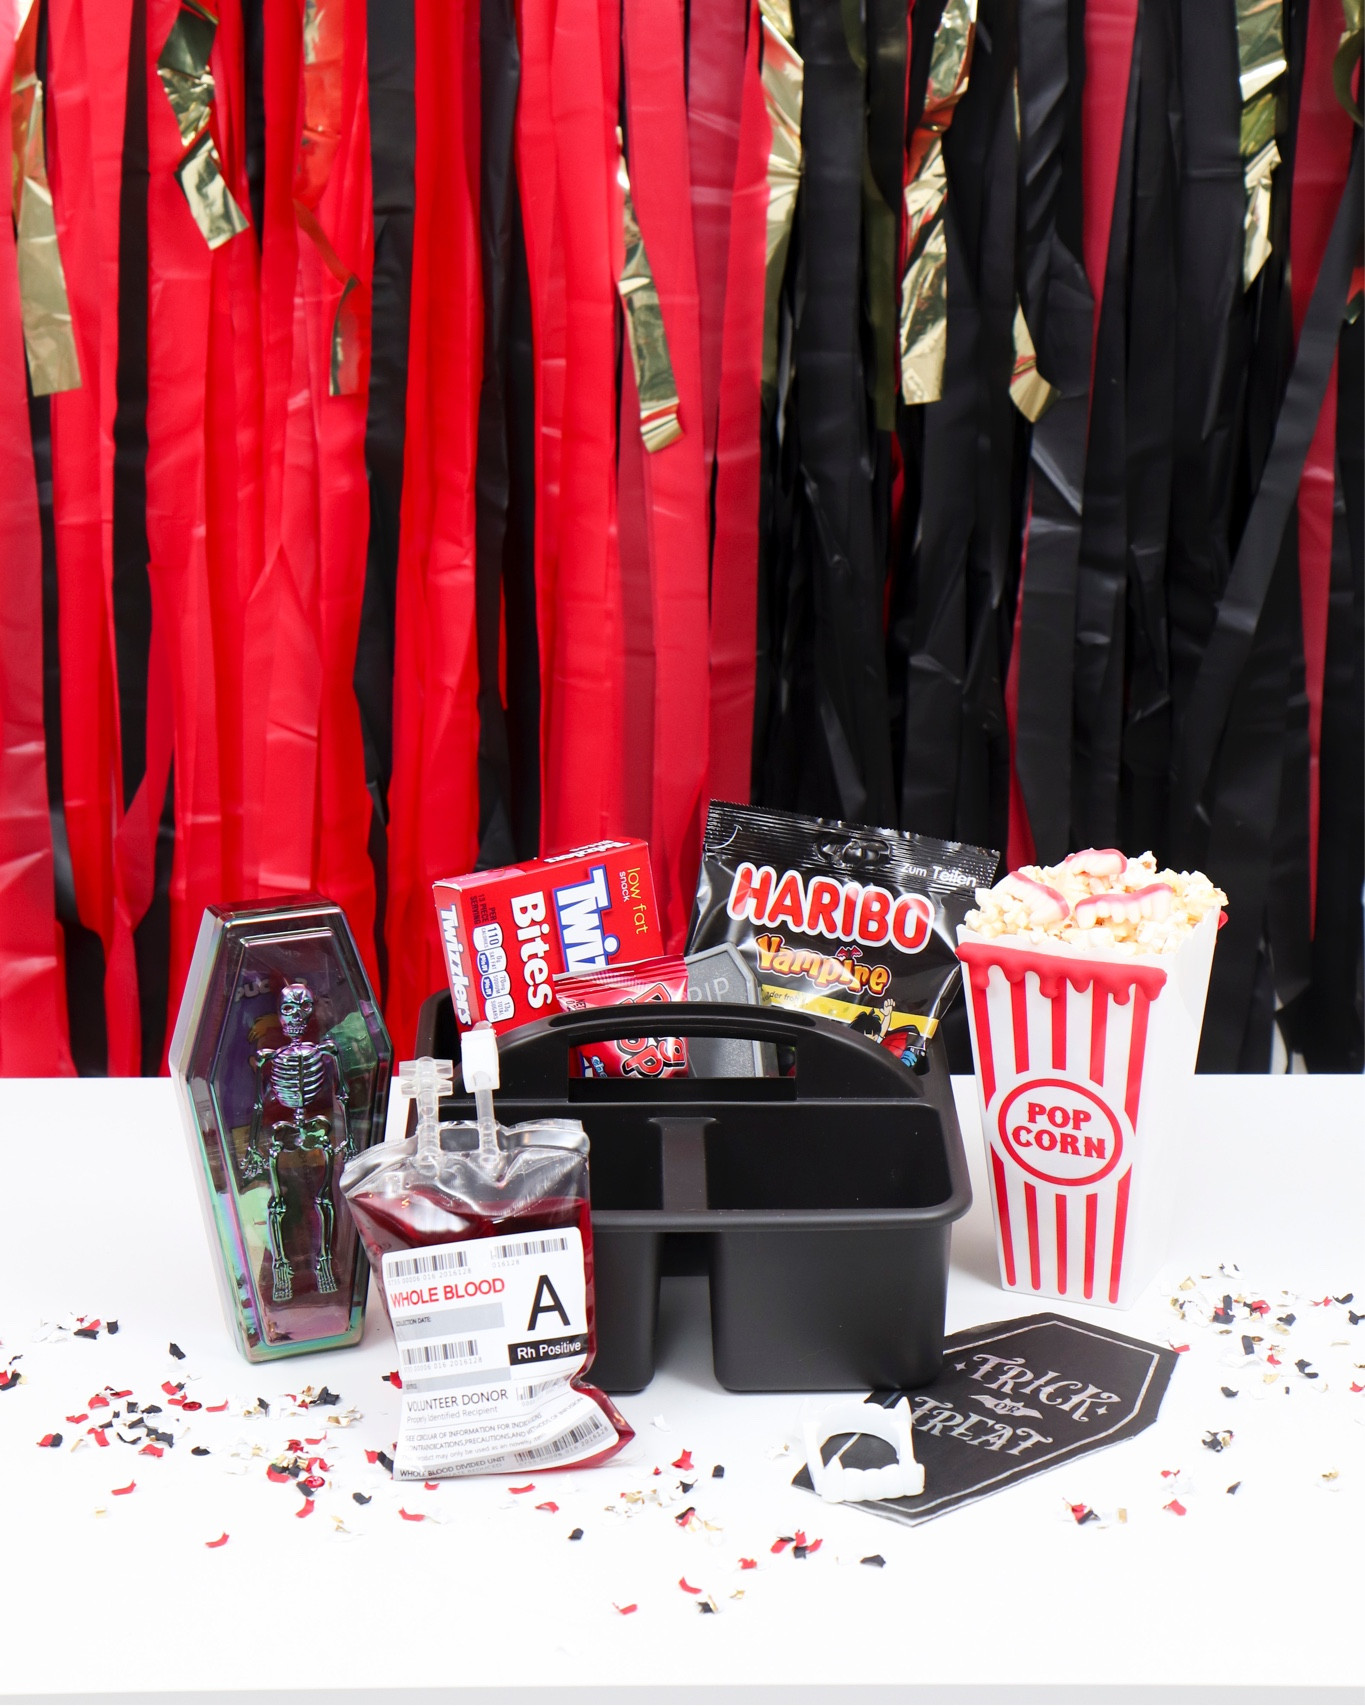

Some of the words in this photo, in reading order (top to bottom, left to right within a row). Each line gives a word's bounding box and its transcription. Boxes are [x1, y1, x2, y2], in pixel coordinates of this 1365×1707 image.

[618, 871, 629, 902] snack
[627, 867, 641, 899] low
[931, 866, 977, 888] Teilen
[470, 896, 480, 924] SERVING
[480, 903, 489, 923] PIECE
[489, 907, 497, 920] PER
[632, 903, 648, 934] fat
[728, 863, 934, 951] HARIBO
[487, 927, 500, 946] 110
[510, 891, 552, 1009] Bites
[441, 904, 472, 1026] Twizzlers
[756, 934, 891, 996] Vampire
[1027, 1101, 1092, 1133] POP
[1011, 1126, 1107, 1160] CORN
[390, 1287, 440, 1308] WHOLE
[443, 1278, 505, 1300] BLOOD
[527, 1275, 571, 1331] A
[517, 1347, 536, 1360] Rh
[539, 1341, 581, 1356] Positive
[407, 1396, 459, 1412] VOLUNTEER
[461, 1390, 508, 1406] DONOR
[969, 1354, 1121, 1422] TRICK
[428, 1411, 460, 1421] Identified
[462, 1406, 498, 1418] Recipient
[994, 1402, 1020, 1413] OR
[439, 1431, 447, 1439] OF
[448, 1425, 495, 1437] INFORMATION
[497, 1423, 510, 1431] FOR
[912, 1396, 1053, 1455] TREAT
[428, 1466, 454, 1477] BLOOD
[456, 1460, 486, 1471] DIVIDED
[487, 1456, 505, 1465] UNIT
[450, 1450, 463, 1458] only
[475, 1445, 489, 1453] used
